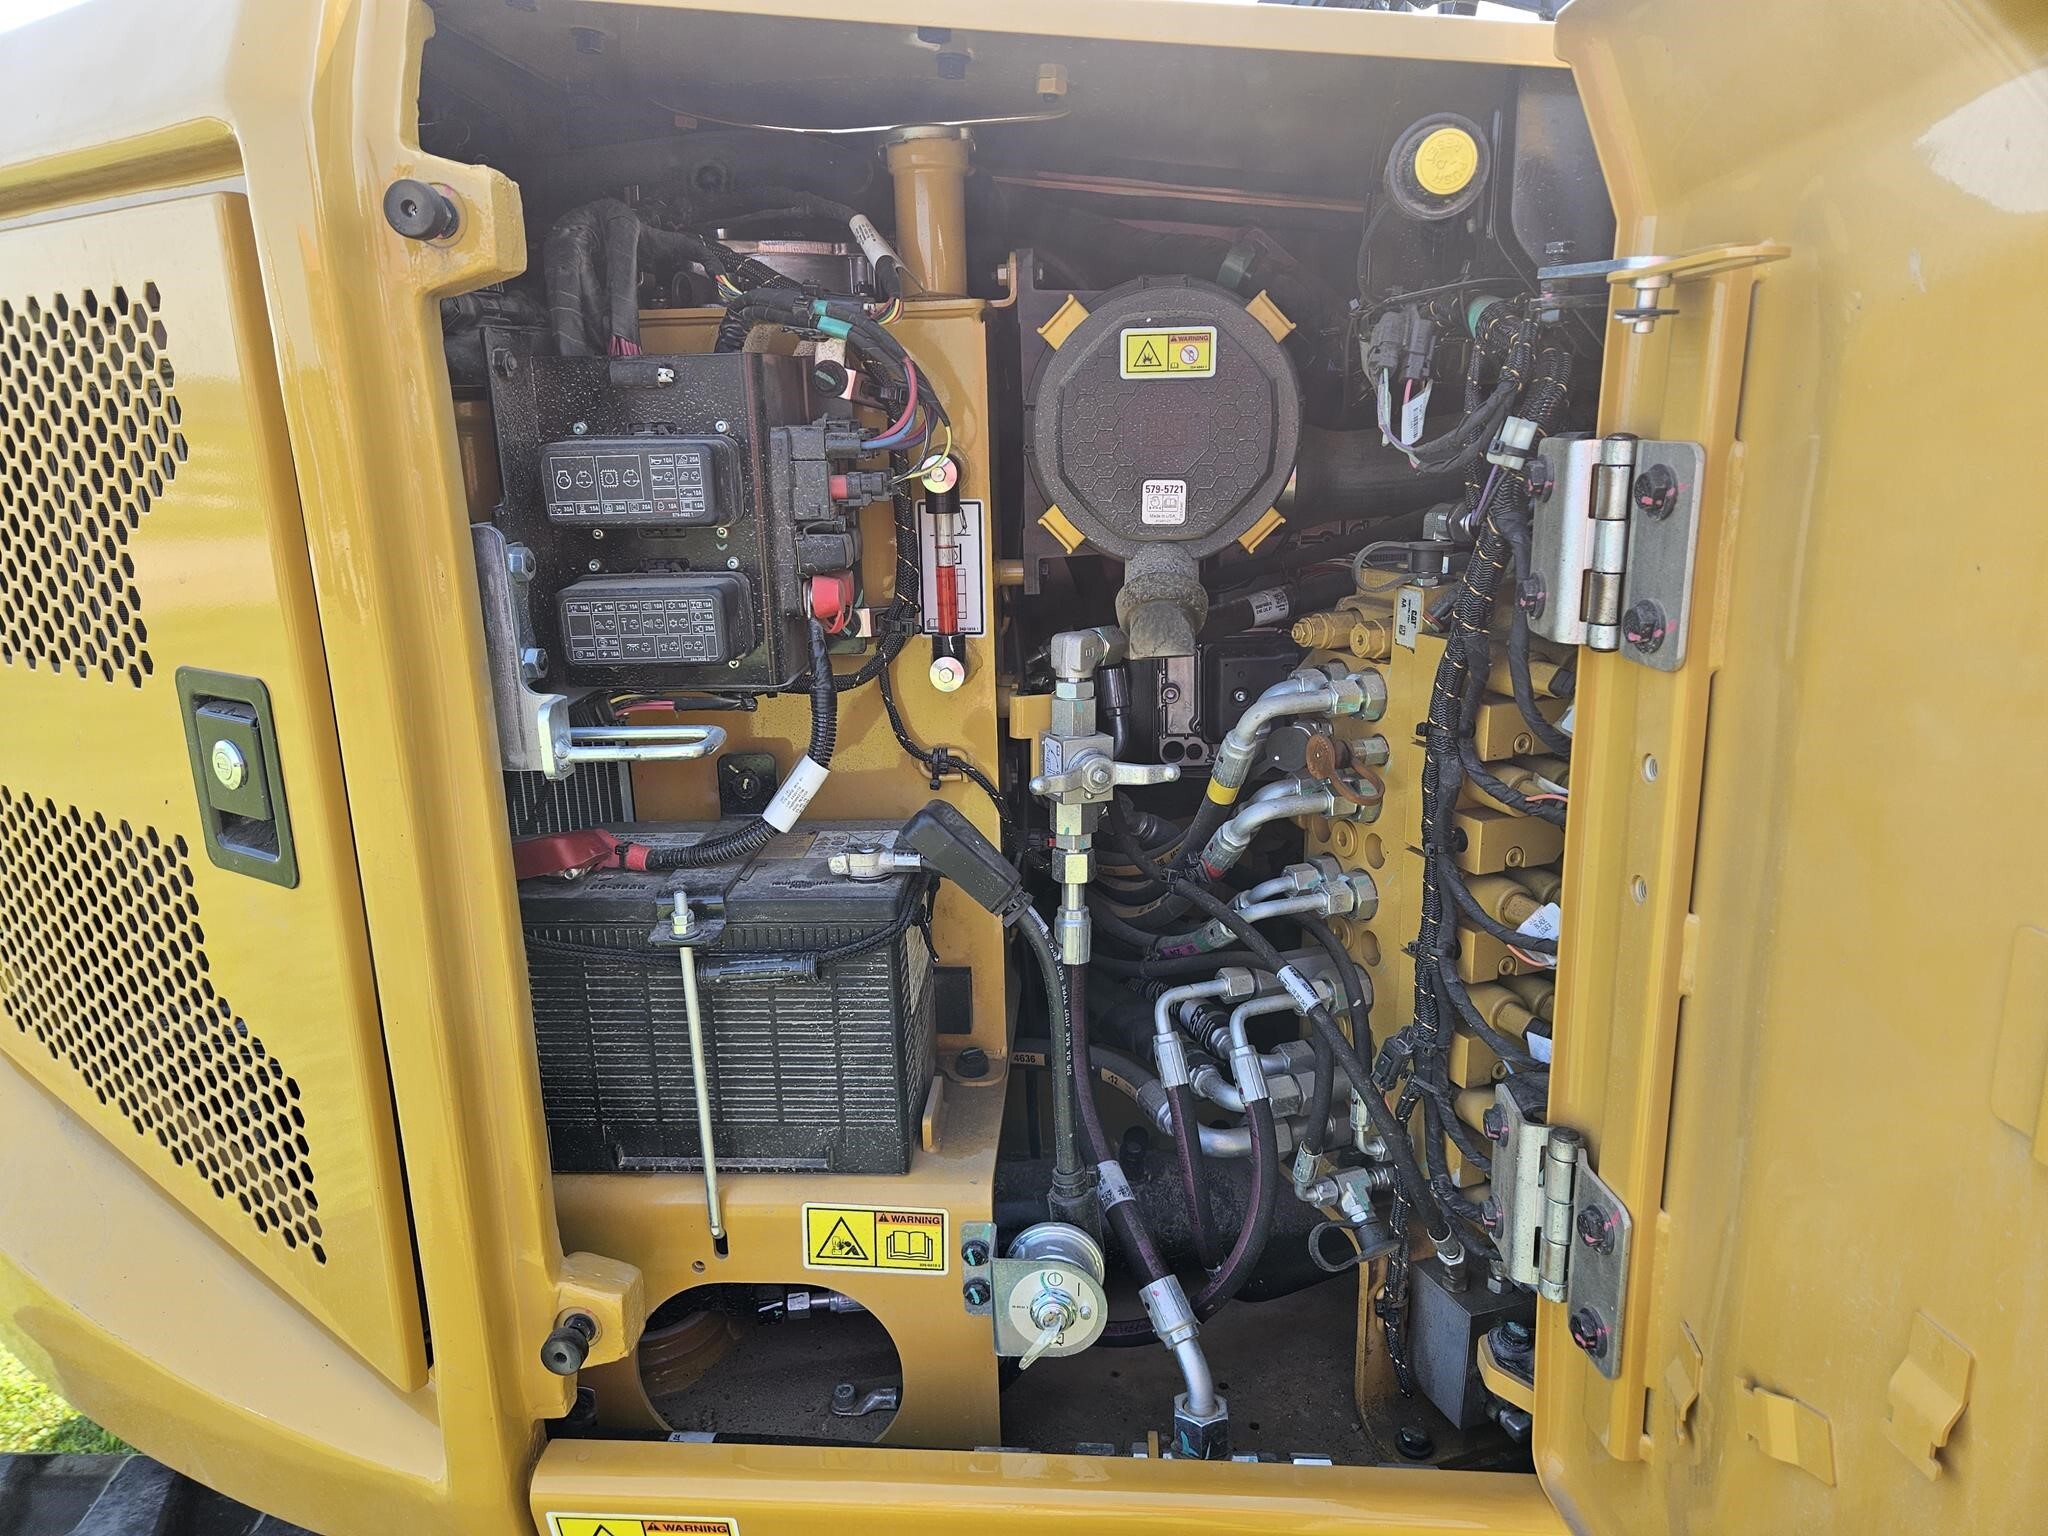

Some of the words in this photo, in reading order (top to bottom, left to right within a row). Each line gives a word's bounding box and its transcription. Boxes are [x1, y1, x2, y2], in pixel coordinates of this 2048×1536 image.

[1145, 485, 1183, 494] 579-5721
[1061, 985, 1069, 1004] TYPE
[1013, 1055, 1036, 1063] 4636
[891, 1214, 940, 1224] WARNING
[663, 1524, 728, 1533] WARNING
